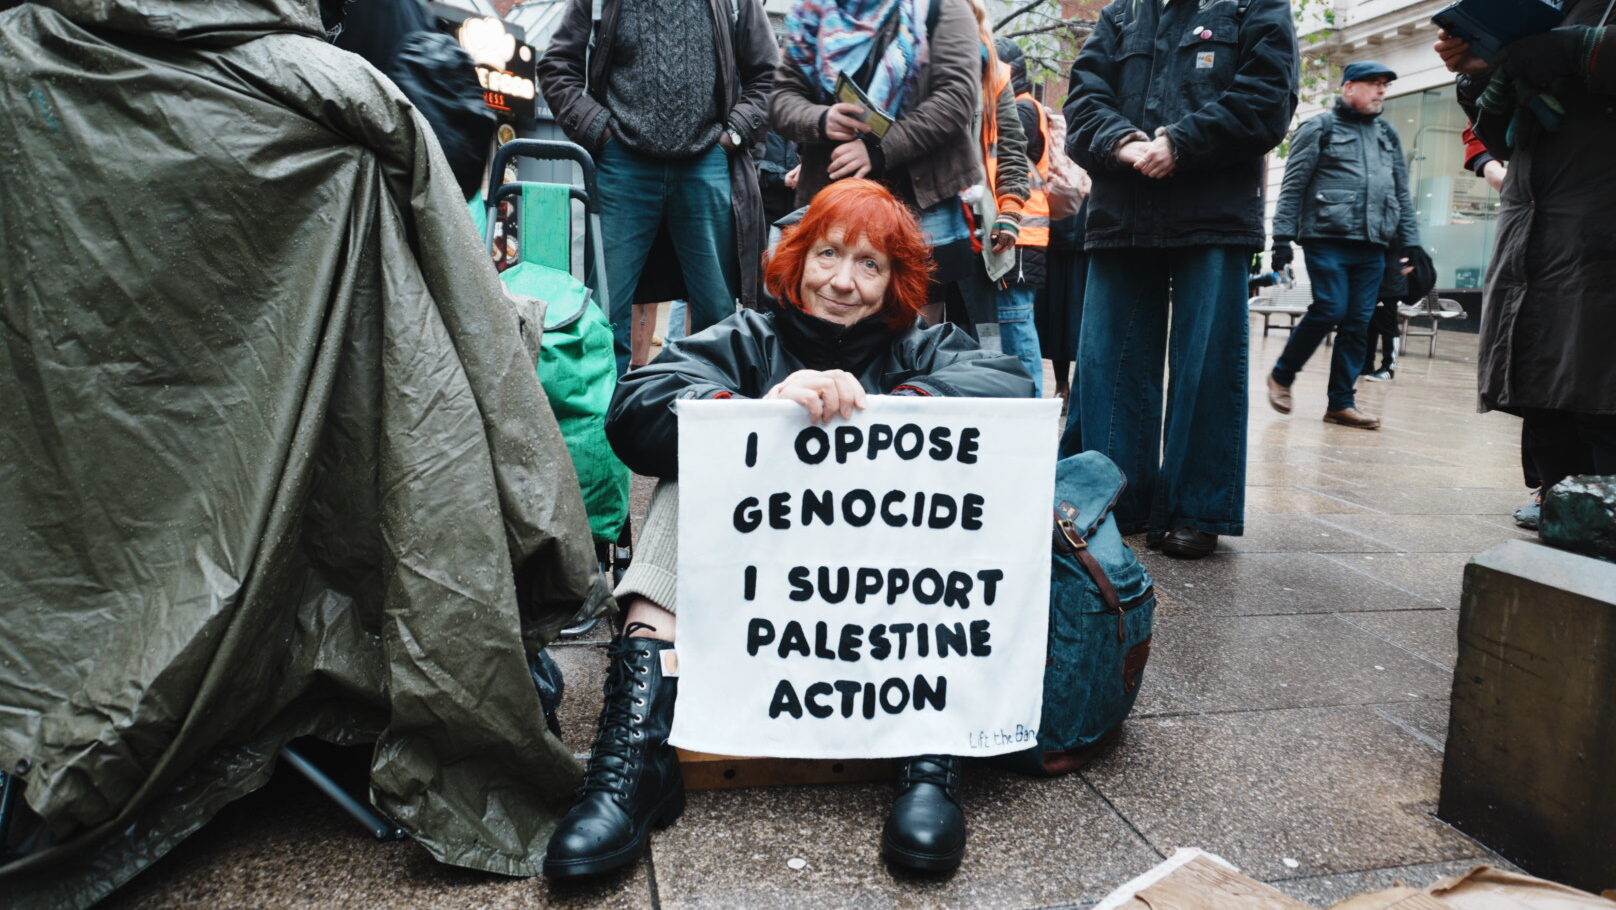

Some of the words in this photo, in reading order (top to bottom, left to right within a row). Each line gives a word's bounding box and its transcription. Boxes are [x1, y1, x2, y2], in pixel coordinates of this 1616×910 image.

[745, 431, 758, 468] I
[794, 423, 980, 465] OPPOSE
[733, 488, 985, 534] GENOCIDE
[744, 565, 757, 601] I
[788, 565, 1004, 610] SUPPORT
[746, 617, 992, 663] PALESTINE
[768, 674, 947, 720] ACTION
[969, 730, 990, 749] Lift
[993, 728, 1013, 746] the
[1015, 723, 1036, 743] Ban
